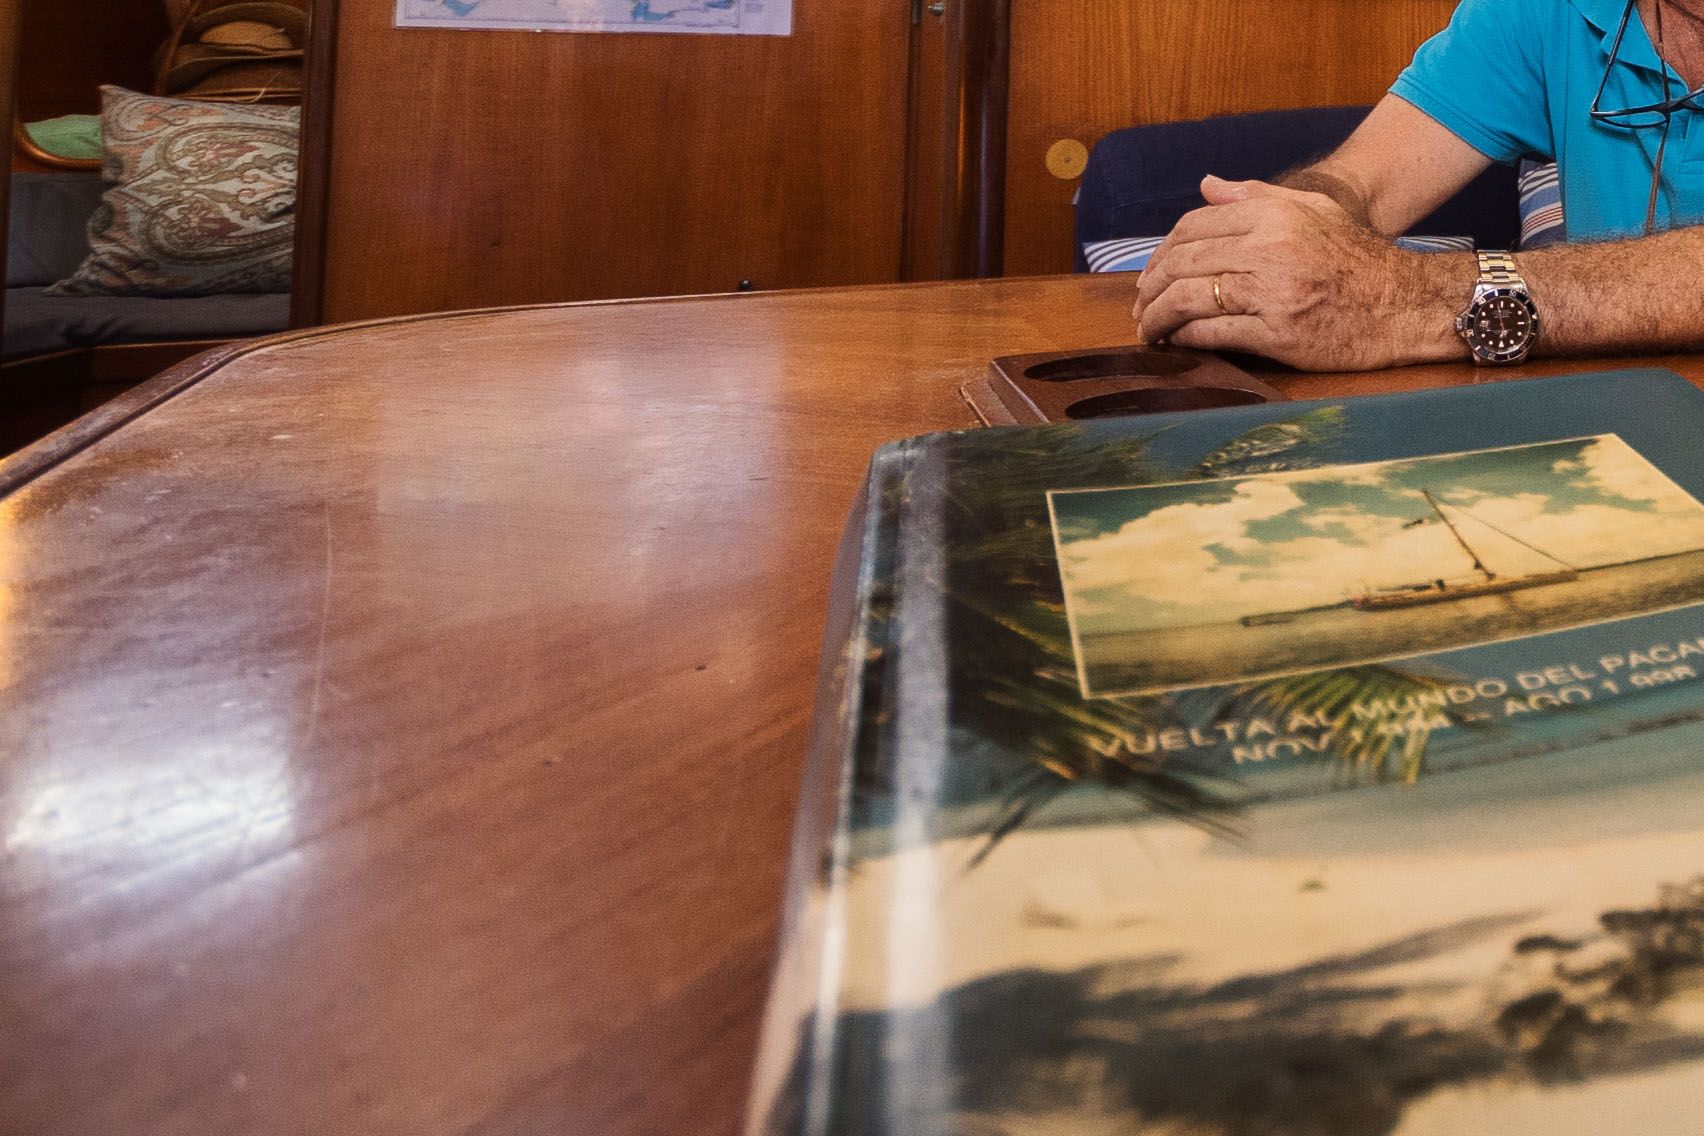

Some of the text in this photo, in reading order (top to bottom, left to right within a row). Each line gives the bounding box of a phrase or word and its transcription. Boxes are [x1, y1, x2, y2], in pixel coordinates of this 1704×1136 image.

[1082, 719, 1278, 757] VUELTA
[1352, 678, 1508, 720] MUNDO
[1515, 662, 1596, 691] DEL
[1231, 730, 1334, 764] NOV
